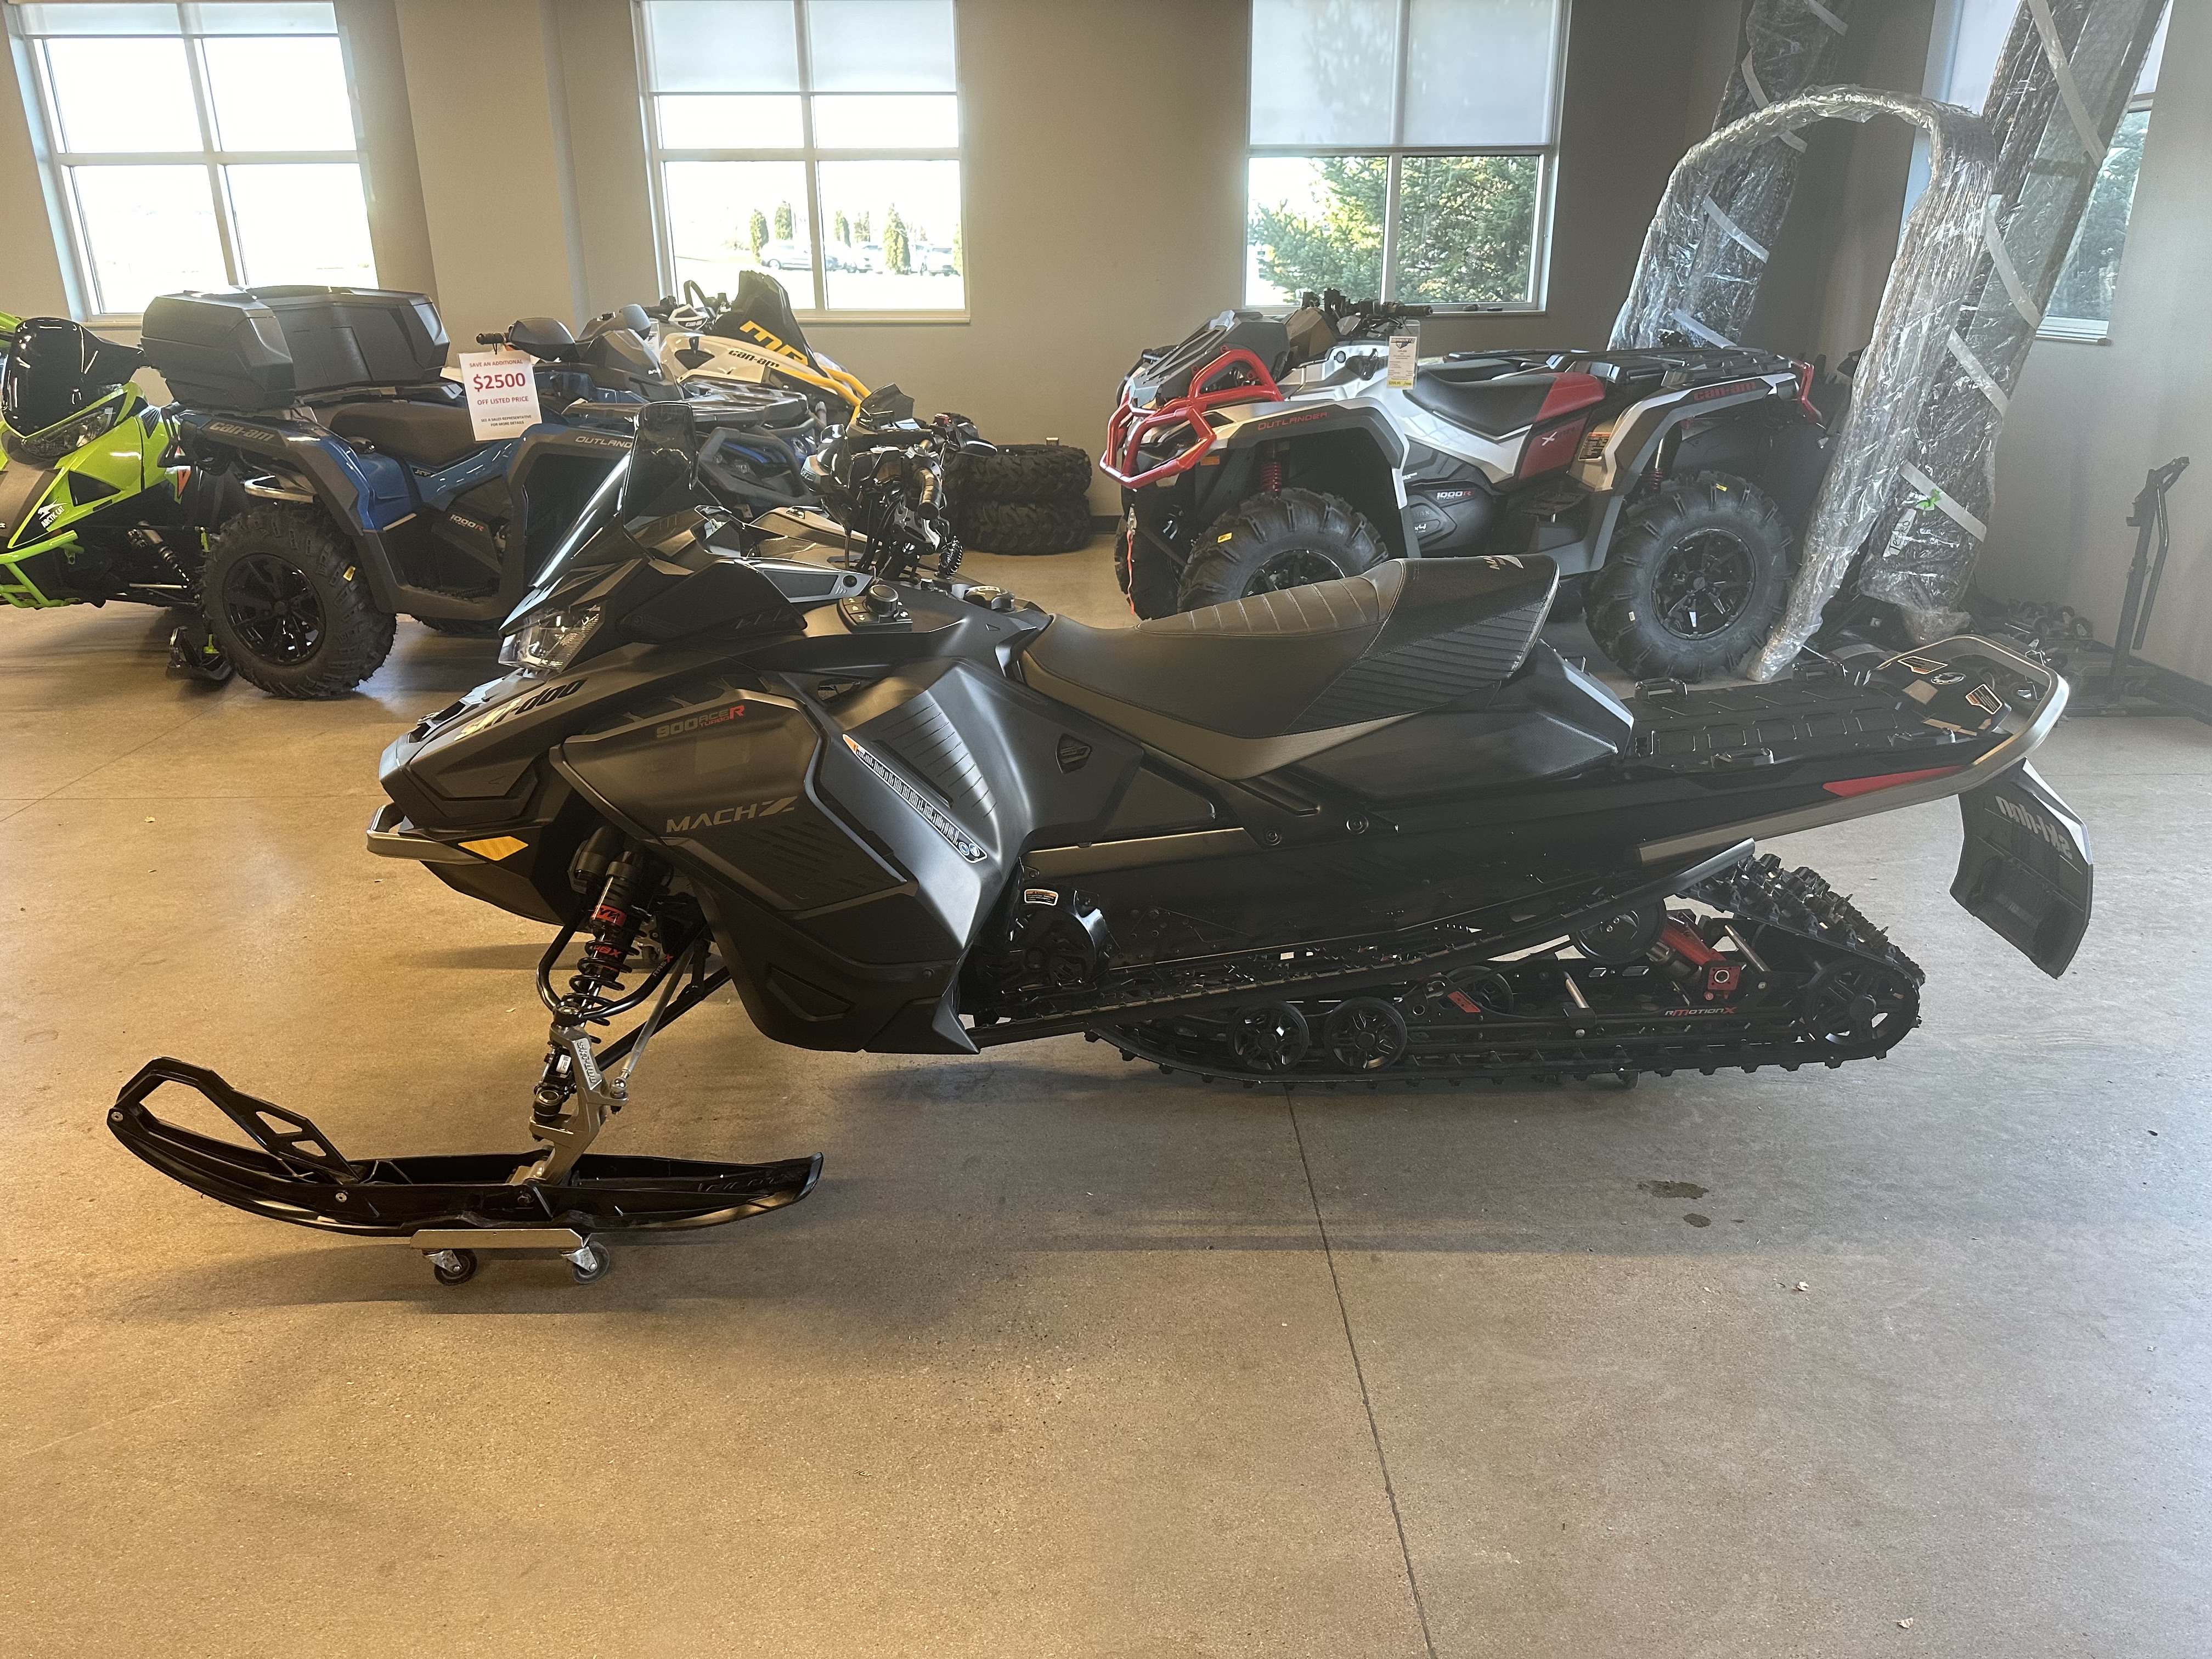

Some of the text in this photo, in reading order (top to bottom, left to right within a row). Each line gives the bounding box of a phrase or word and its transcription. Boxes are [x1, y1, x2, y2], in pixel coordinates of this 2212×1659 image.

[729, 350, 780, 368] can-am
[473, 373, 526, 392] $2500
[1694, 381, 1756, 401] can-am
[1257, 412, 1328, 431] OUTLANDER
[210, 422, 274, 442] can-am
[575, 436, 633, 449] OUTLAND
[1437, 490, 1471, 499] 1000R
[41, 505, 65, 528] ARCTIC CAT
[450, 514, 484, 532] 1000R
[657, 705, 745, 738] 900 ACE TURBO R
